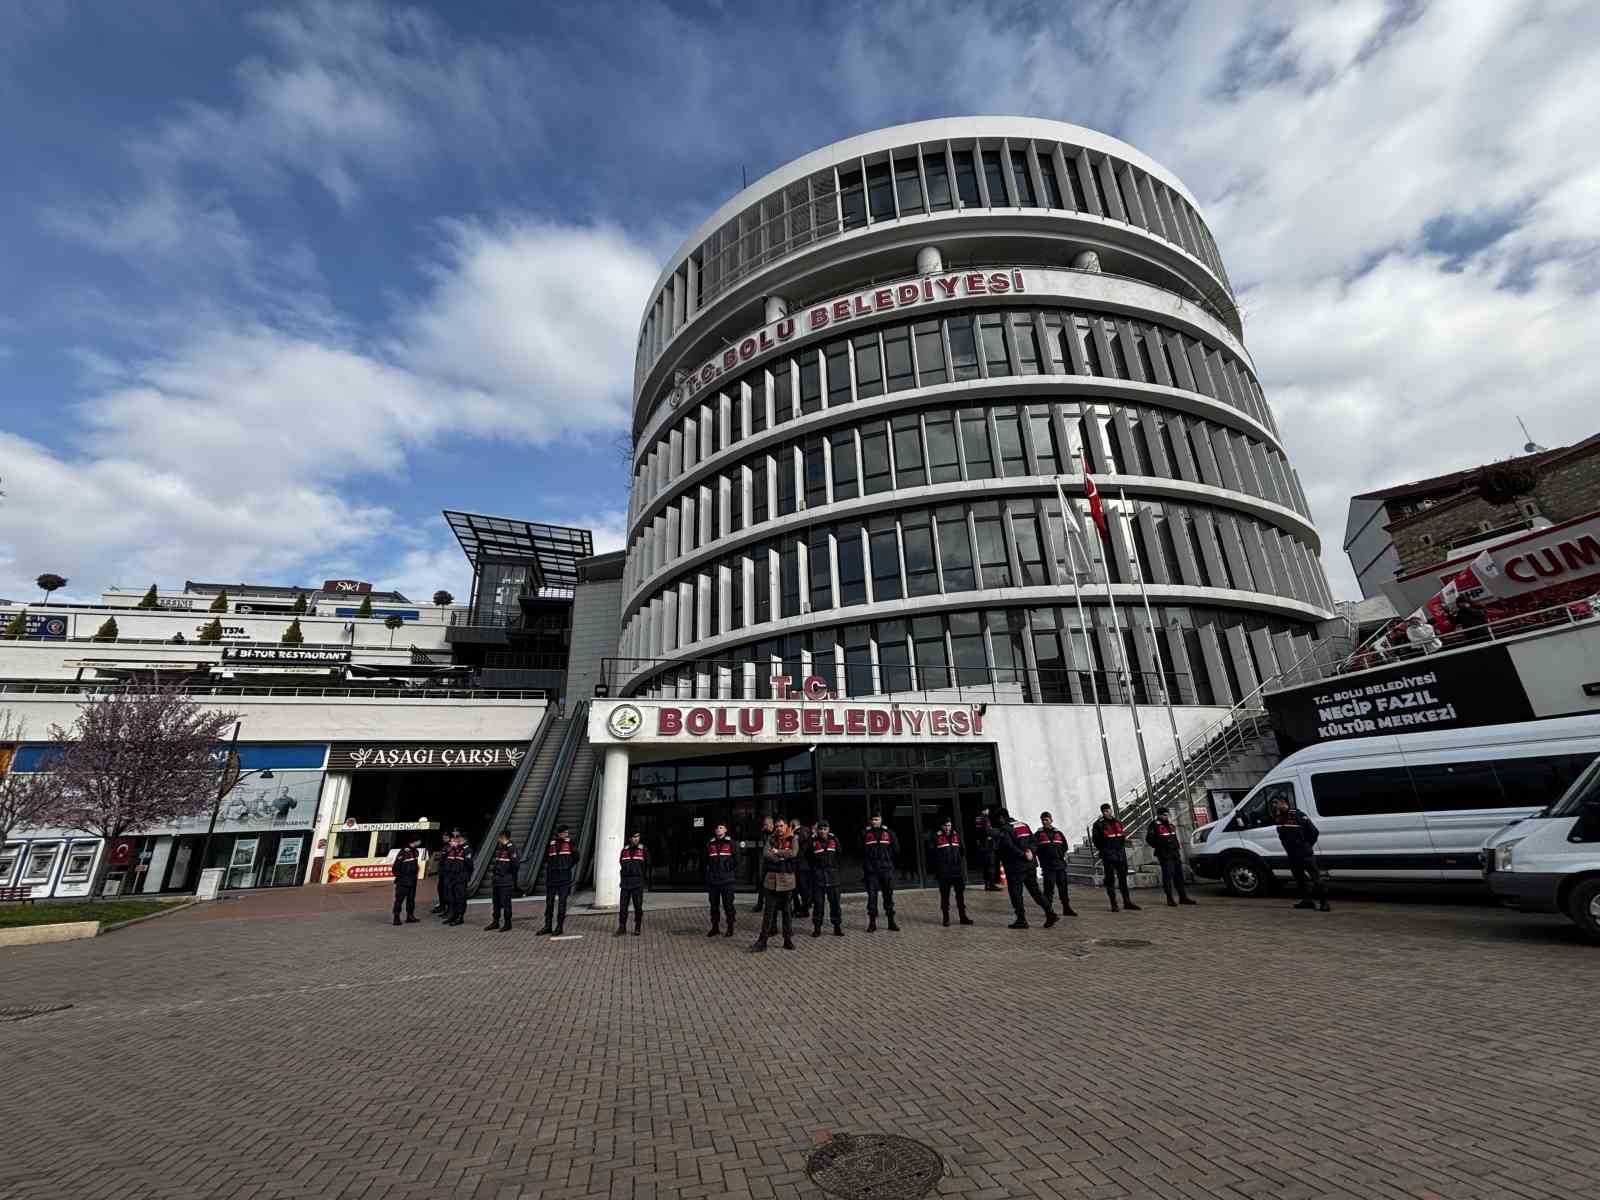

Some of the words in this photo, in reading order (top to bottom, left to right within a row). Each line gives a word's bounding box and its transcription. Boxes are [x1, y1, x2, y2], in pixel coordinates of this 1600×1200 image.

[724, 318, 796, 371] BOLU
[811, 266, 1025, 331] BELEDİYESİ
[279, 651, 347, 660] RESTAURANT
[769, 675, 838, 700] T.C.
[1313, 696, 1333, 705] T.C.
[1333, 689, 1363, 701] BOLU
[1365, 672, 1437, 694] BELEDİYESİ
[658, 707, 764, 735] BOLU
[776, 703, 985, 736] BELEDİYESİ
[1318, 699, 1372, 721] NECİP
[1375, 690, 1439, 712] FAZIL
[1318, 718, 1376, 737] KÜLTÜR
[1377, 703, 1456, 729] MERKEZİ
[441, 749, 500, 768] ÇARŞI
